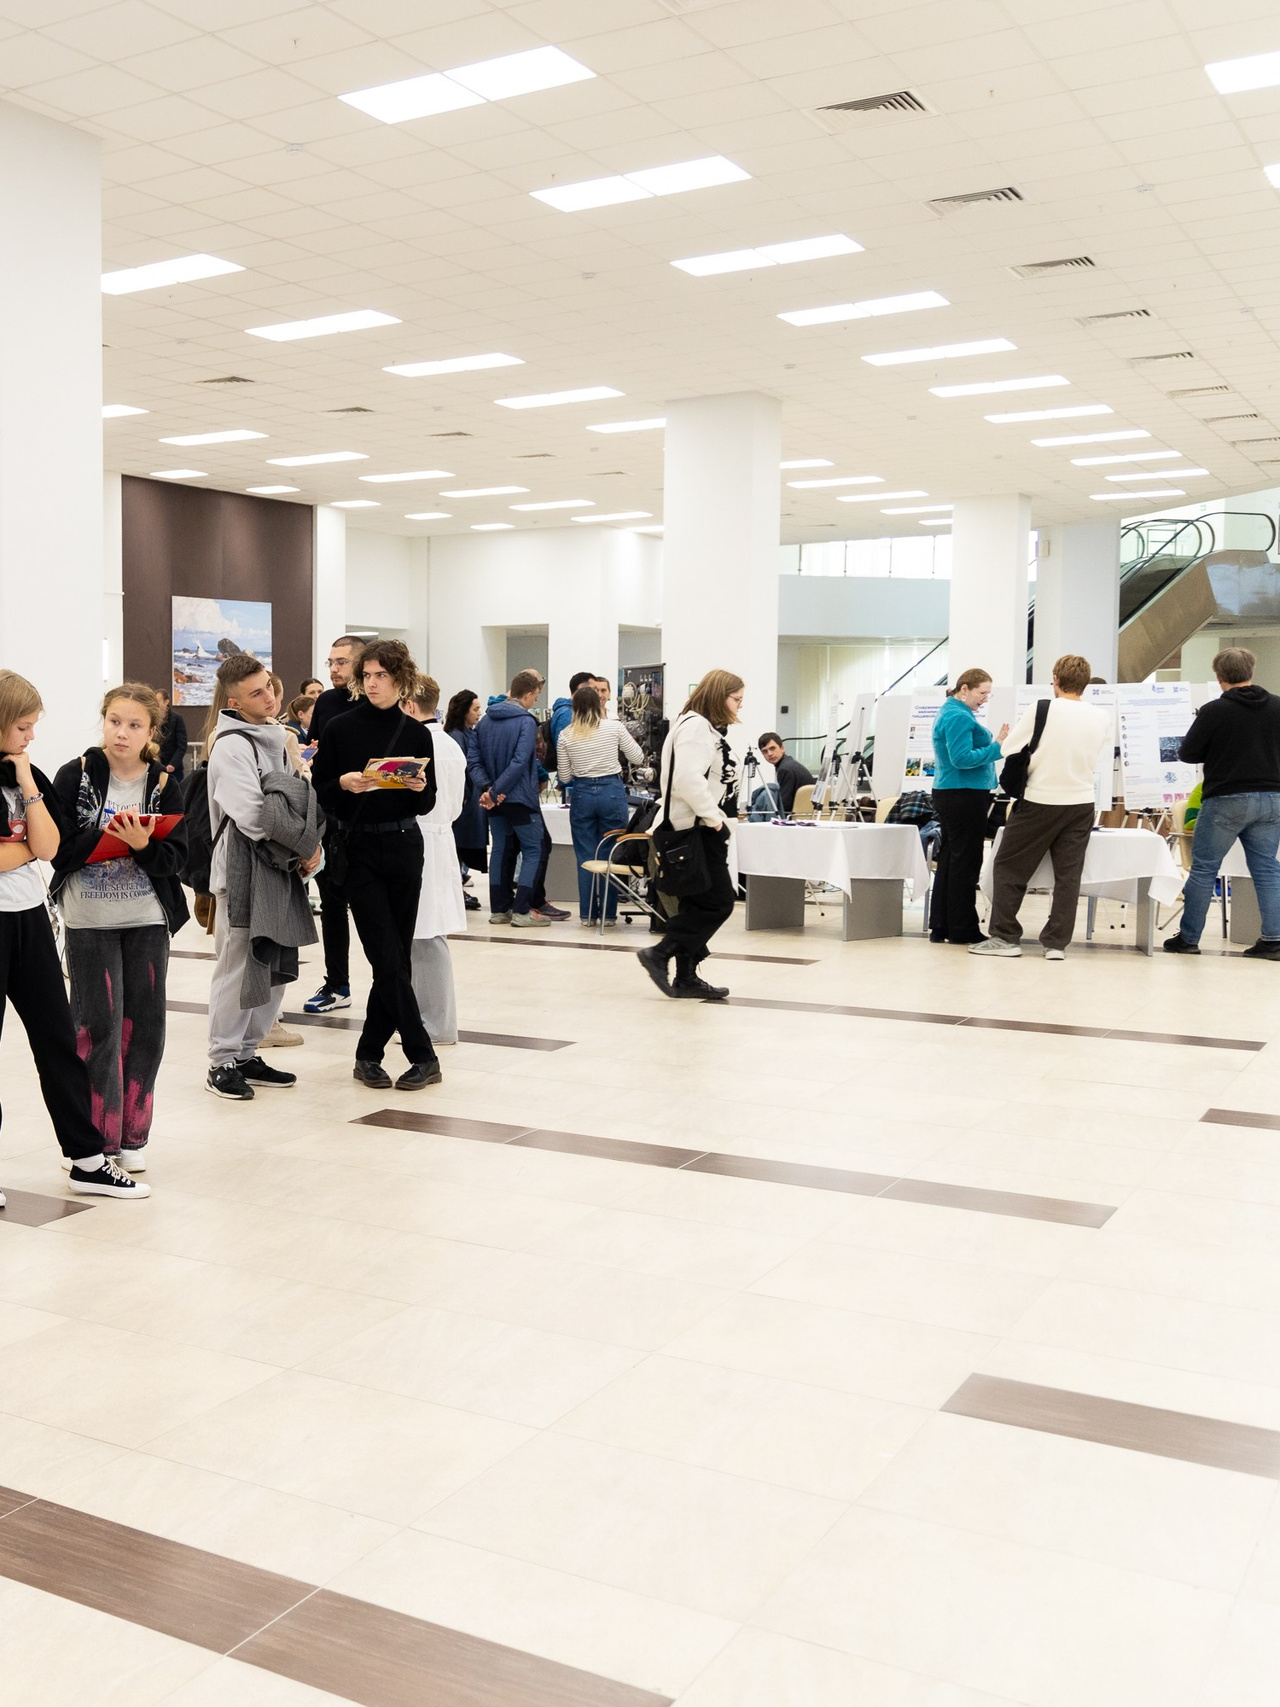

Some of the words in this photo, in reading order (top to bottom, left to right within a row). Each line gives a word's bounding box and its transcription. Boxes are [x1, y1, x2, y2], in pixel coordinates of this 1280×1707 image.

[111, 882, 139, 891] SECRET
[80, 891, 119, 900] FREEDOM
[120, 891, 128, 899] IS
